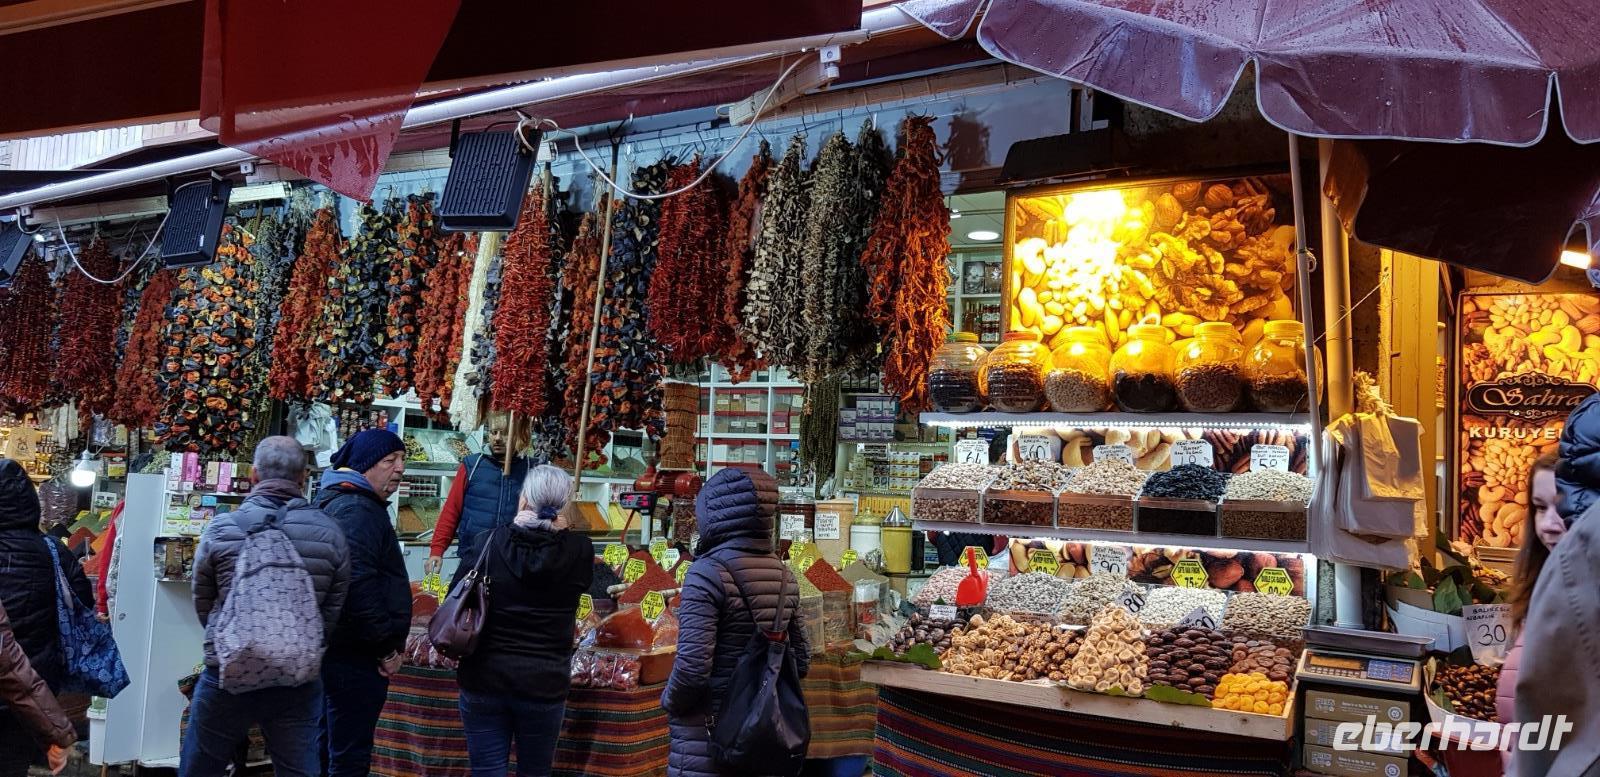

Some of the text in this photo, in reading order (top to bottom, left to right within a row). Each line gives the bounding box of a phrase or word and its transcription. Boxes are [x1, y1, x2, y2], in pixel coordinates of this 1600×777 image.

[1483, 388, 1582, 406] Sahra
[1123, 592, 1146, 613] 80
[1477, 624, 1507, 646] 30
